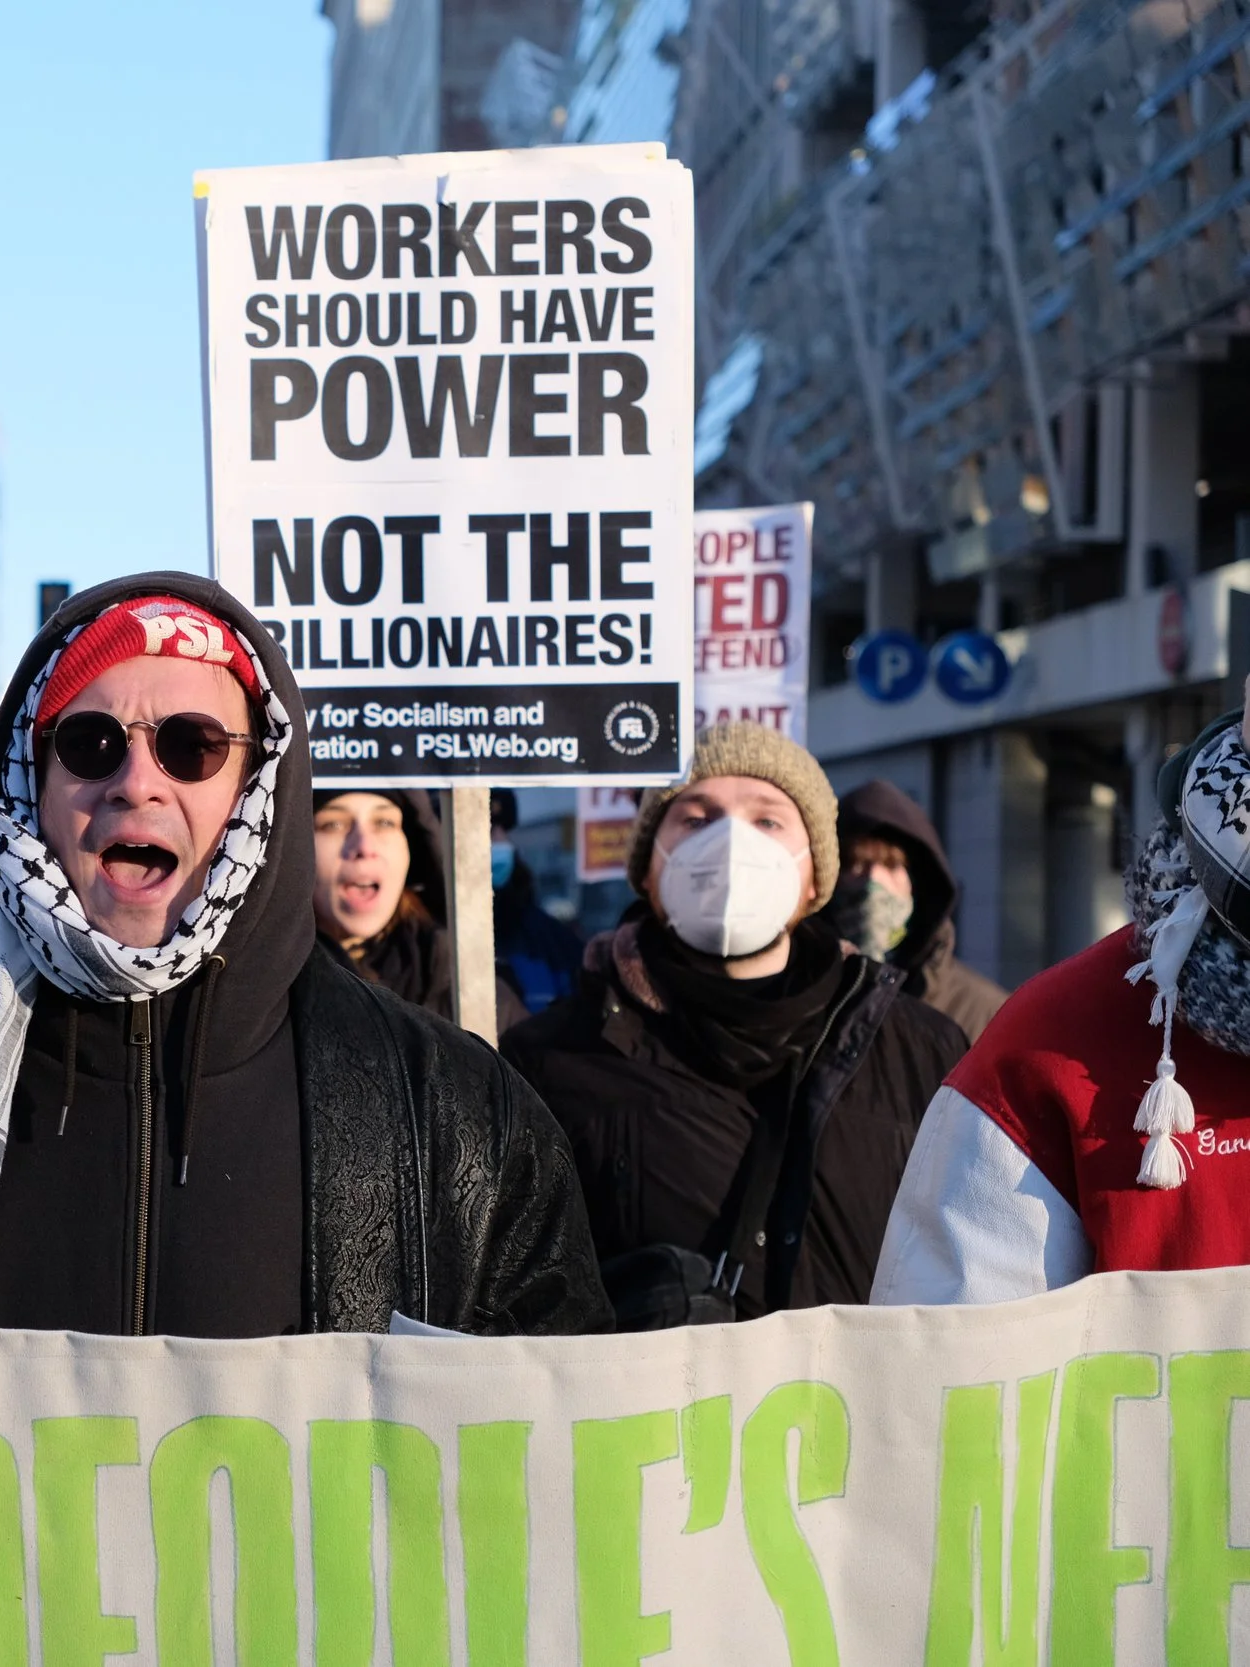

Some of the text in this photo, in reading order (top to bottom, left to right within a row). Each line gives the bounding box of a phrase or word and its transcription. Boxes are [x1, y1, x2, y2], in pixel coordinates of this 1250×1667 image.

[244, 197, 653, 281] WORKERS
[244, 287, 655, 349] SHOULD HAVE
[249, 351, 652, 461] POWER
[252, 510, 654, 606] NOT THE
[138, 614, 235, 663] PSL
[879, 646, 911, 691] P
[321, 703, 359, 728] for
[363, 702, 489, 728] Socialism
[493, 701, 544, 727] and
[416, 733, 578, 762] PSLWeb.org
